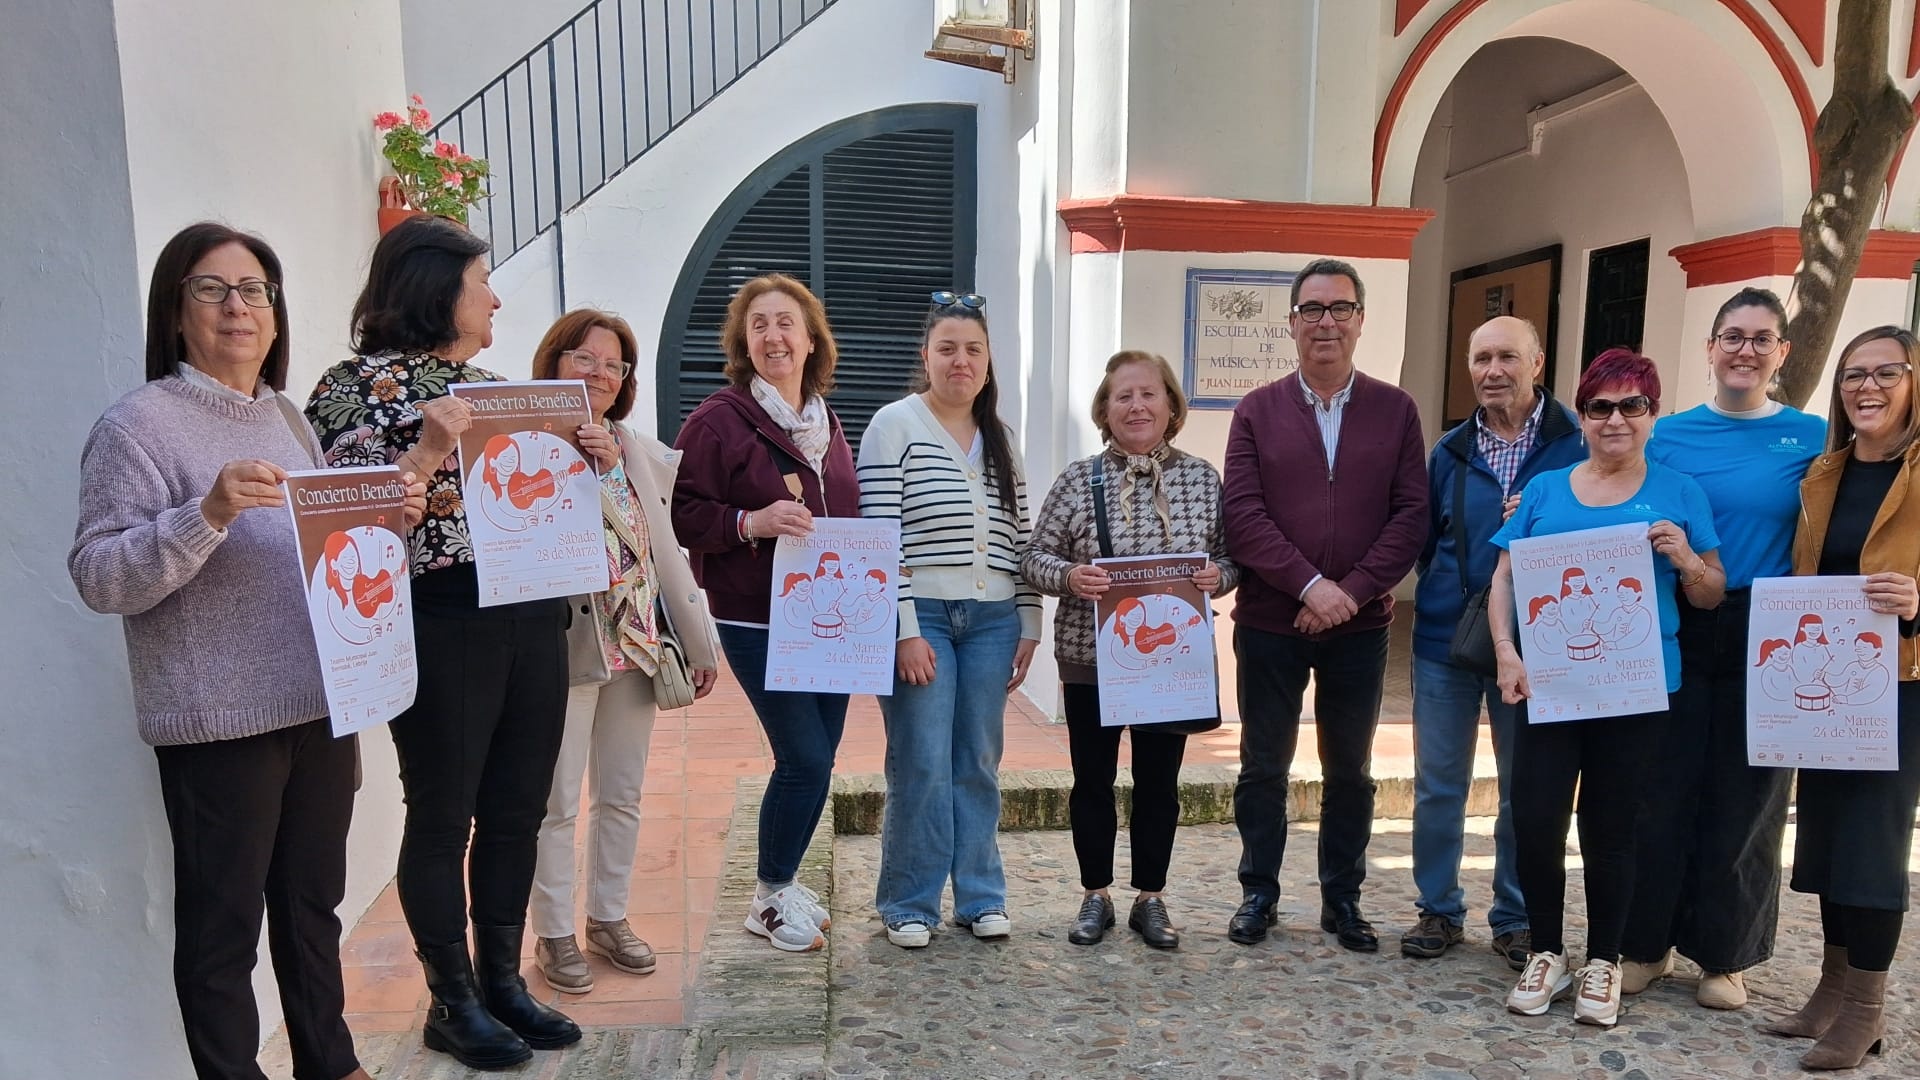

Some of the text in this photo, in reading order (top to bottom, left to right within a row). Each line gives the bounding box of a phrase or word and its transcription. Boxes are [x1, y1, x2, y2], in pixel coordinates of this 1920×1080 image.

[1204, 325, 1291, 339] ESCUELA MUN
[1259, 343, 1275, 353] DE
[1210, 354, 1300, 369] MÚSICA Y DAN
[1234, 378, 1254, 388] LUIS
[529, 391, 582, 410] Benéfico
[296, 485, 359, 506] Concierto
[558, 530, 597, 546] Sábado
[843, 536, 893, 550] Benéfico
[536, 545, 599, 561] 28 de Marzo
[1520, 552, 1583, 571] Concierto
[1585, 543, 1643, 562] Benéfico
[1104, 566, 1154, 581] oncierto
[1759, 597, 1824, 611] Concierto
[852, 642, 888, 653] Martes
[824, 652, 887, 665] 24 de Marzo
[1615, 656, 1656, 671] Martes
[1173, 669, 1208, 681] Sábado
[1588, 674, 1601, 686] 24
[1603, 672, 1617, 685] de
[1620, 669, 1657, 683] Marzo
[1151, 681, 1209, 694] 28 de Marzo
[1845, 715, 1888, 727] Martes
[1812, 726, 1889, 739] 24 de Marzo
